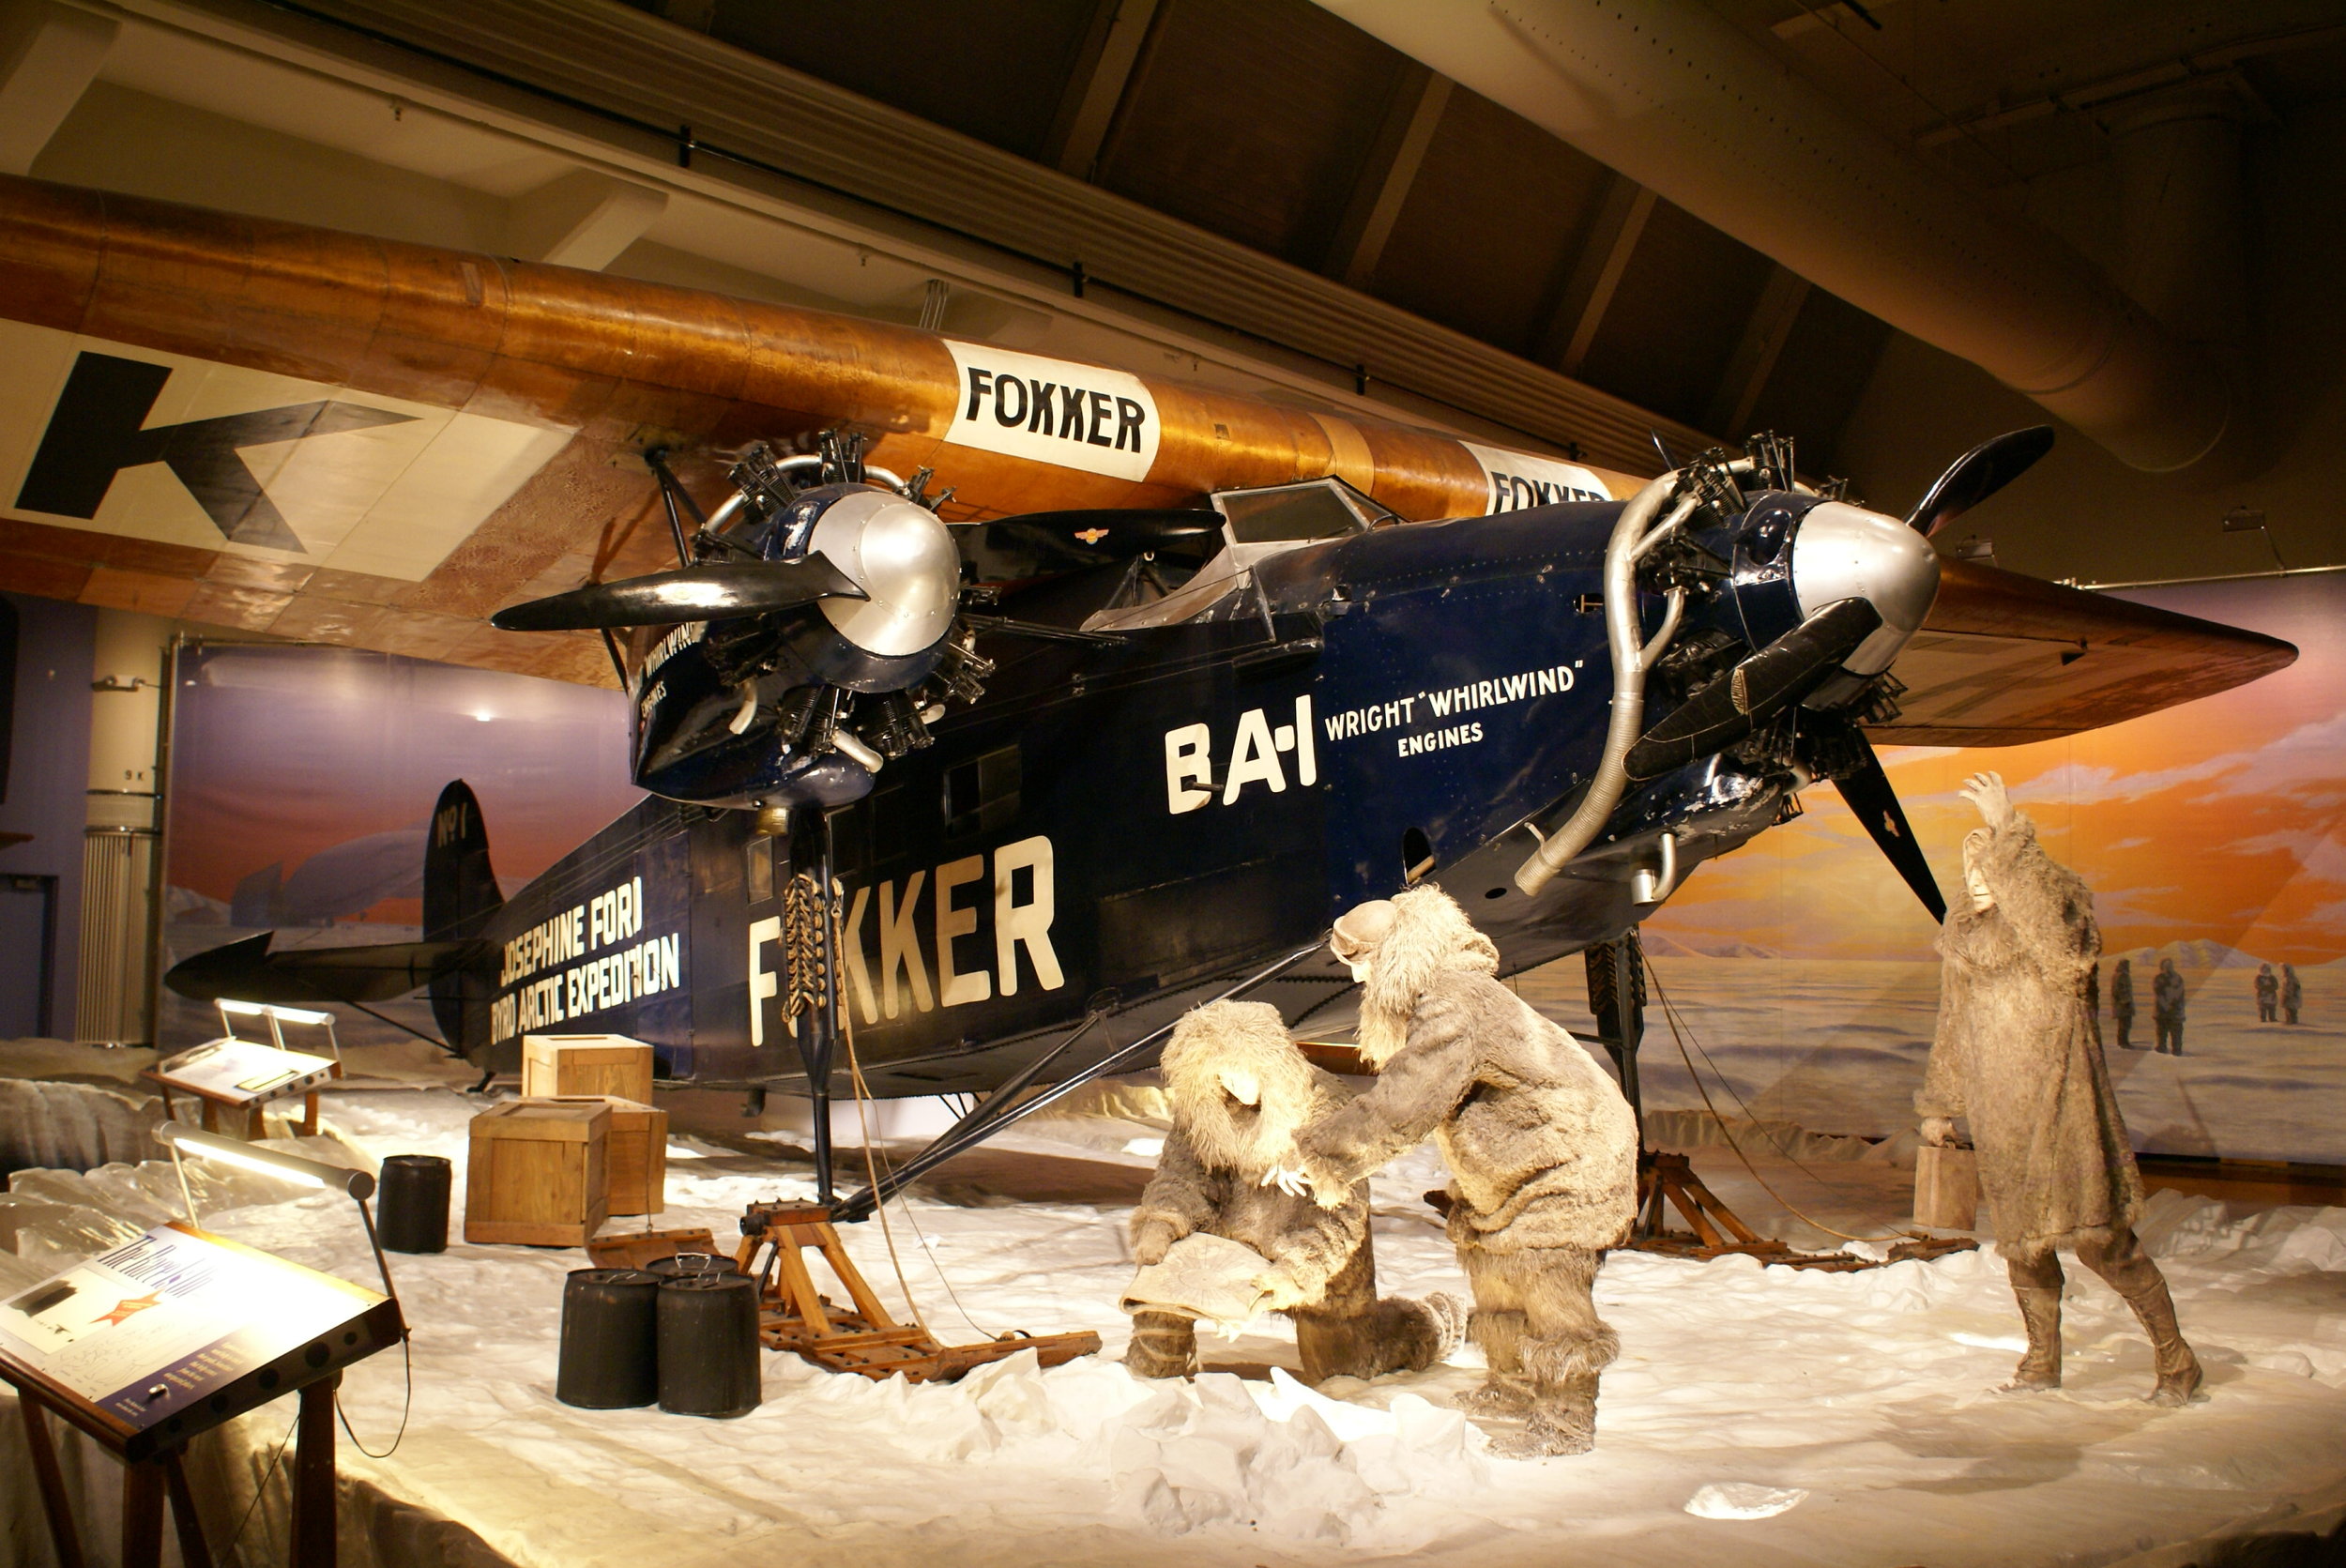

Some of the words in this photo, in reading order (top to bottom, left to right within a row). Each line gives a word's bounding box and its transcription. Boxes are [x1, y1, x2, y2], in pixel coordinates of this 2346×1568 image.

[15, 350, 425, 554] K
[966, 367, 1146, 453] FOKKER
[1325, 697, 1414, 741] WRIGHT
[1398, 722, 1484, 757] ENGINES
[500, 905, 585, 987] JOSEPHINE
[749, 835, 1065, 1047] FKKER
[491, 993, 516, 1045] BYRD
[518, 974, 564, 1034] ARCTIC
[567, 932, 680, 1019] EXPEDITION
